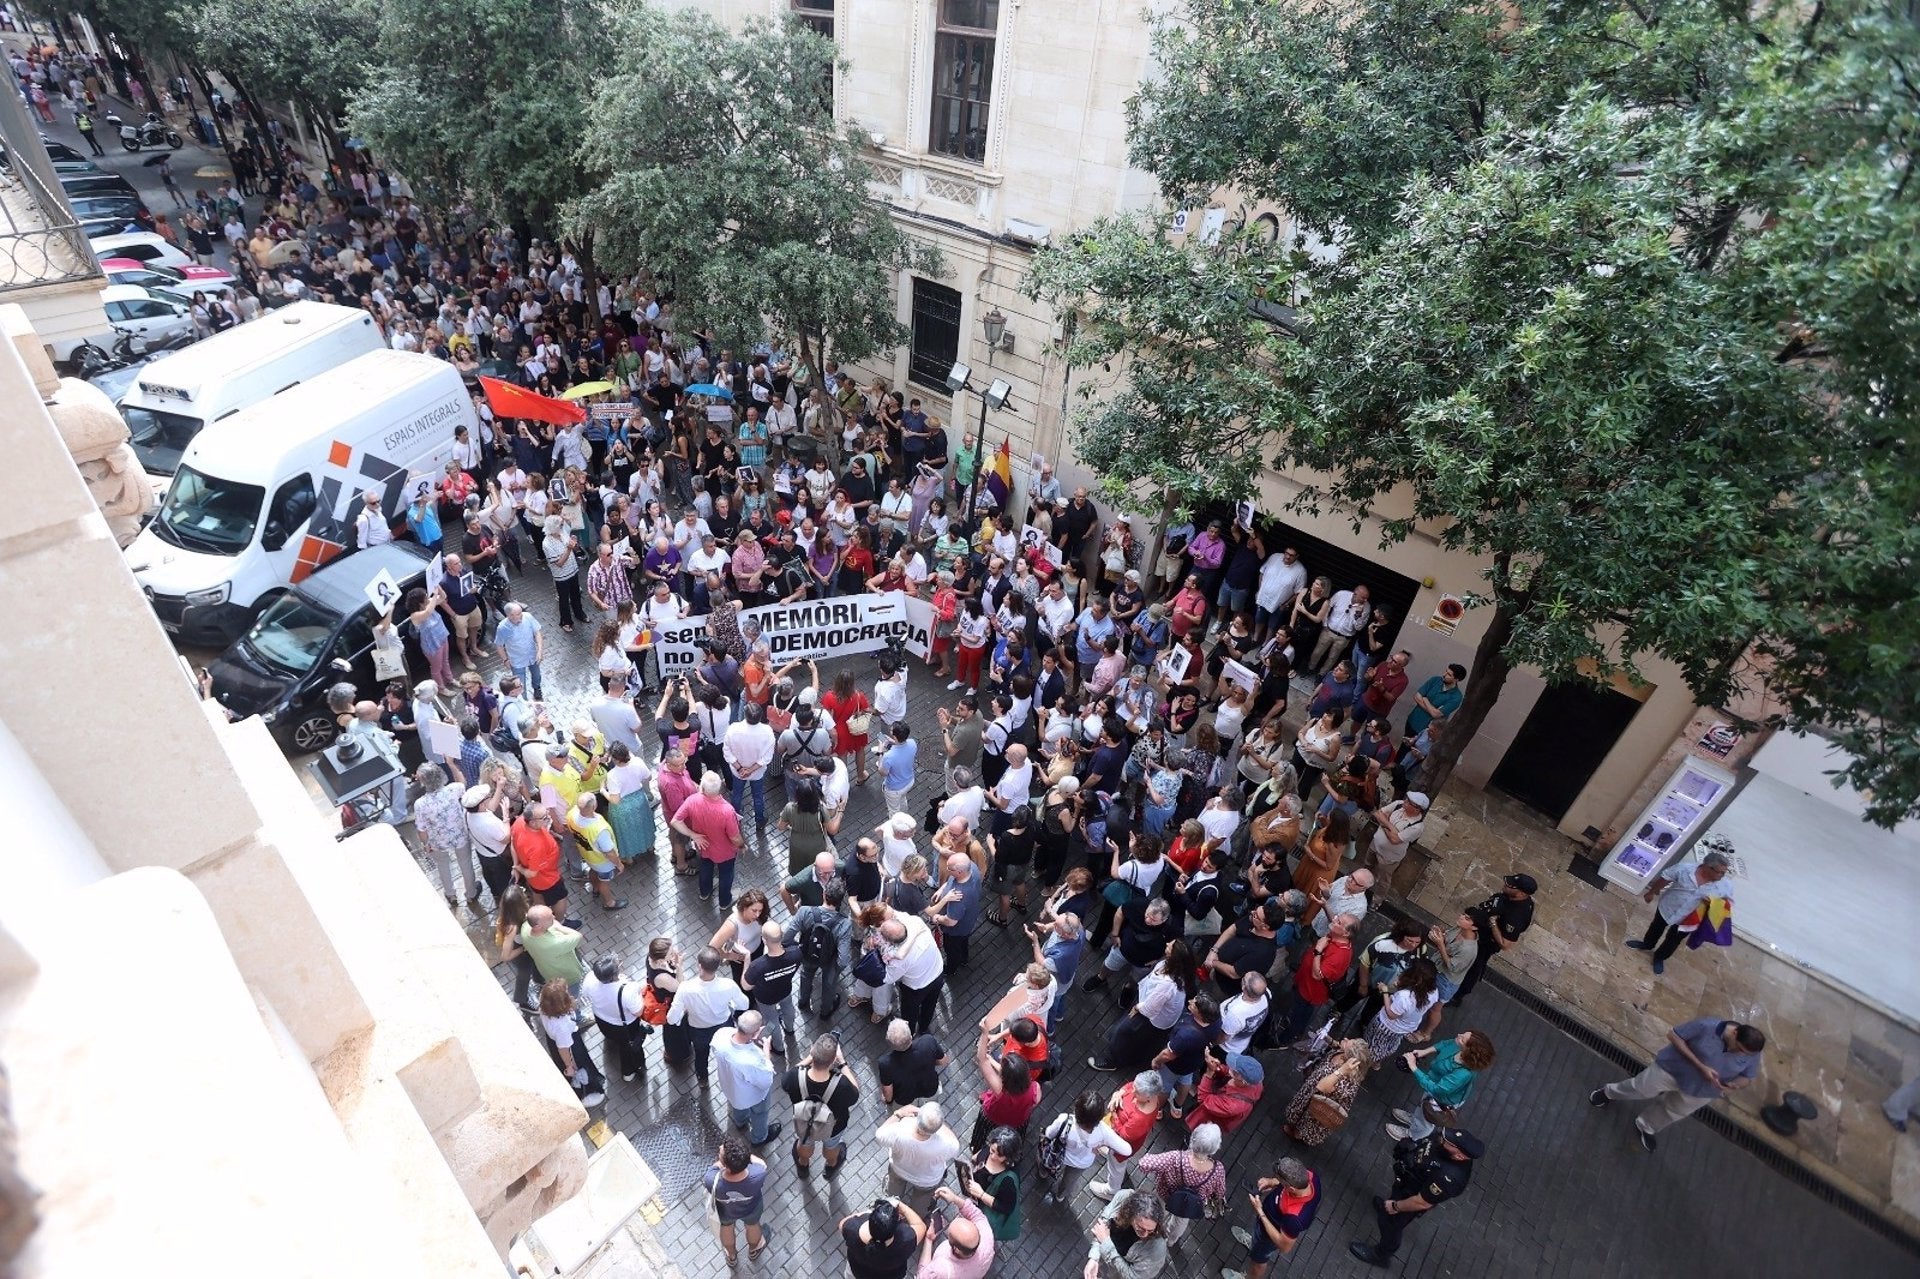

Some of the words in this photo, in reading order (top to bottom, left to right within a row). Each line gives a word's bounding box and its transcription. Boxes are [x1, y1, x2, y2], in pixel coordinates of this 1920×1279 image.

[383, 422, 416, 451] ESPAIS
[414, 398, 462, 434] INTEGRALS
[748, 601, 863, 633] MEMÒRI
[664, 652, 695, 664] no
